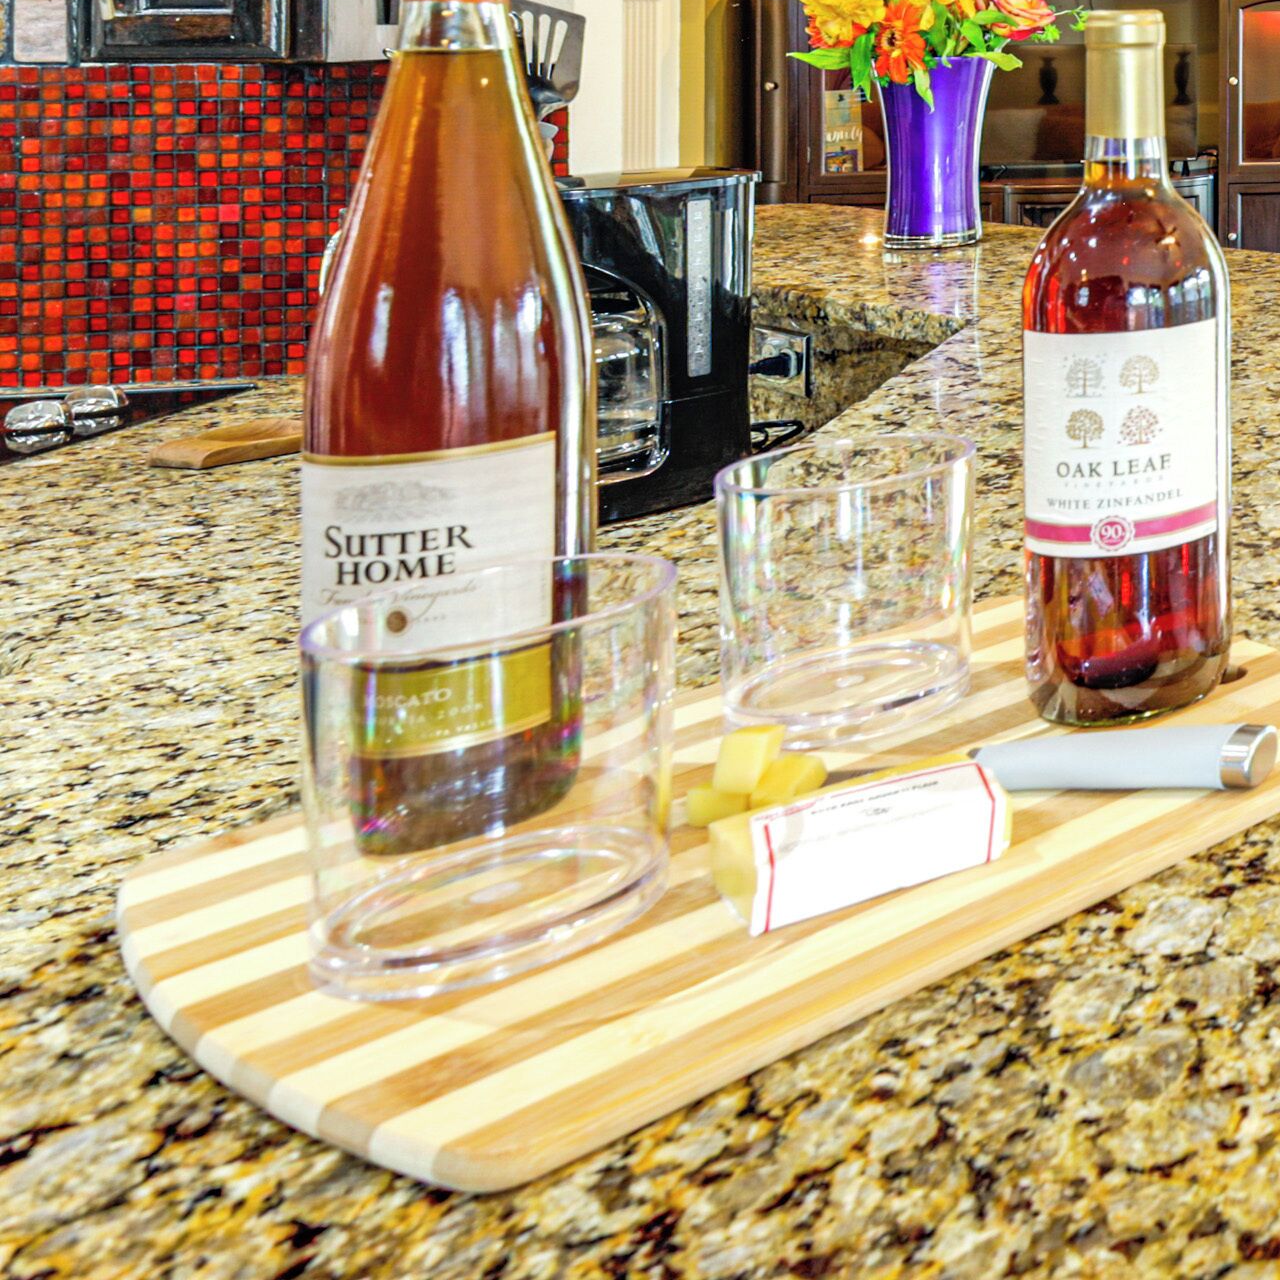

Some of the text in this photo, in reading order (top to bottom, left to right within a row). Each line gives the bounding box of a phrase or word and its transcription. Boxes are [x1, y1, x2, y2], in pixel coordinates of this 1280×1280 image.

[1056, 453, 1172, 478] OAK LEAF
[1047, 487, 1184, 510] WHITE ZINFANDEL
[335, 552, 456, 586] HOME
